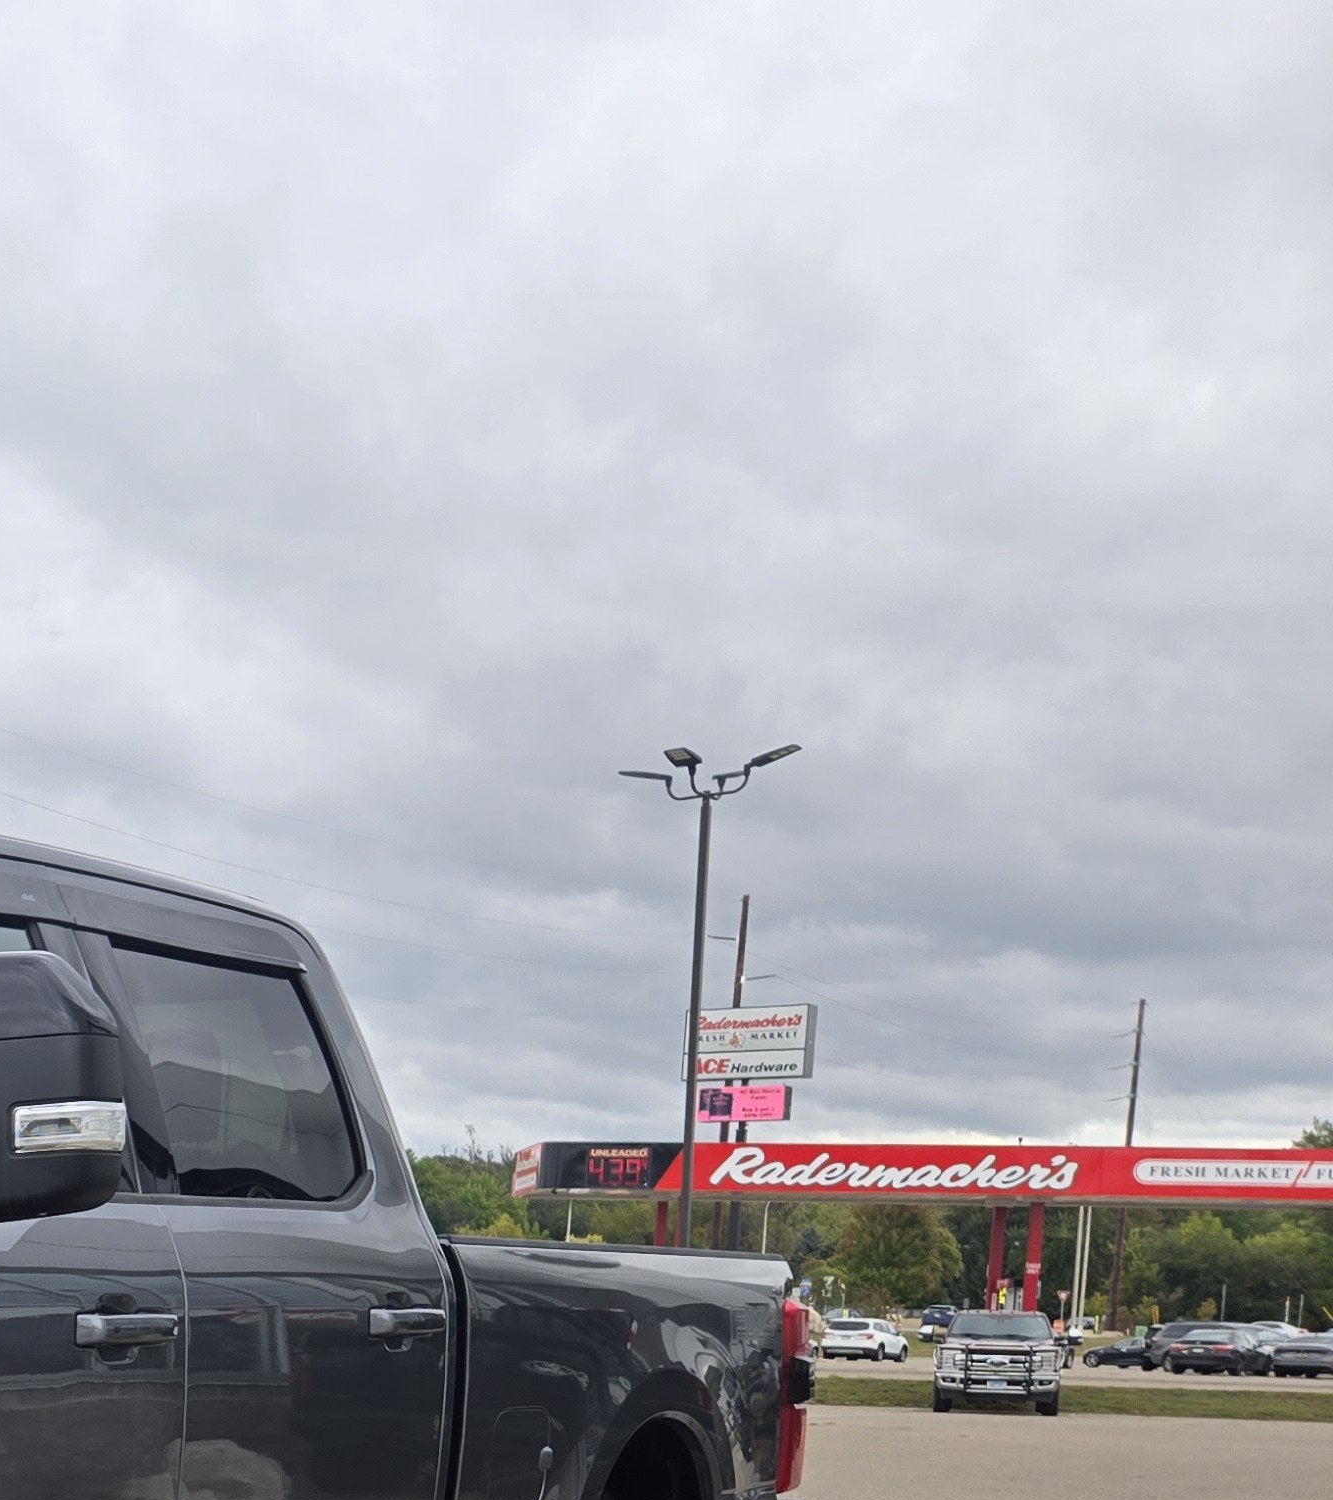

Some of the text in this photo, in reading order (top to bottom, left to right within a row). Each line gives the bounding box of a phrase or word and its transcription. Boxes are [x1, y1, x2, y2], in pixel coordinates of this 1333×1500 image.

[750, 1030, 797, 1040] MARKET
[730, 1062, 798, 1074] Hardware
[709, 1146, 1079, 1190] Radermacher's
[1149, 1165, 1207, 1178] FRESH
[1214, 1166, 1294, 1179] MARKET
